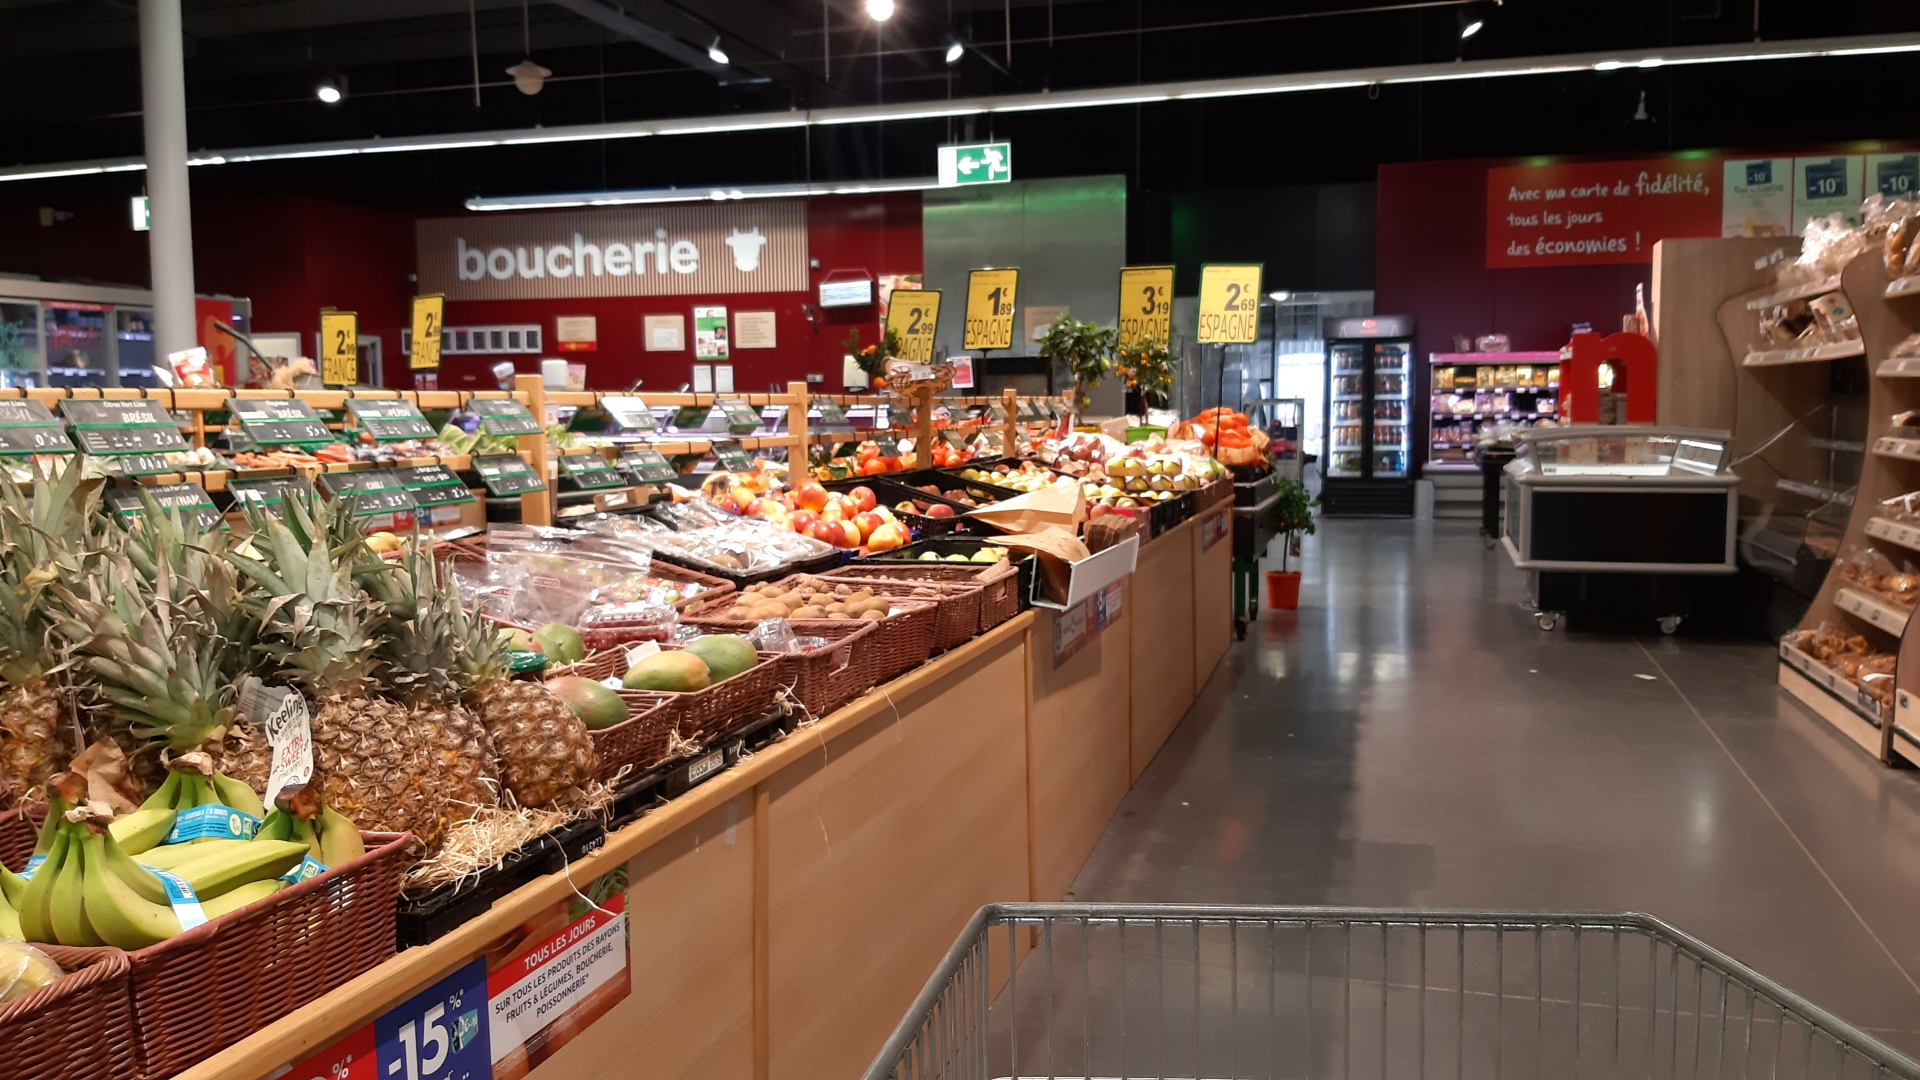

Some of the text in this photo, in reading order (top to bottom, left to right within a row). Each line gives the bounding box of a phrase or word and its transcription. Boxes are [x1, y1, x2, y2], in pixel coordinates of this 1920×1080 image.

[1508, 171, 1710, 201] Avec ma carte de fidélité,
[1507, 210, 1603, 229] tous les jours
[457, 228, 700, 281] boucherie
[1507, 240, 1531, 256] des
[1535, 236, 1628, 255] économies
[965, 319, 1011, 346] ESPAGNE
[1199, 314, 1255, 341] ESPAGNE
[323, 357, 357, 382] FRANCE
[121, 410, 157, 423] BRÉSIL
[280, 744, 304, 773] SWEET
[281, 733, 304, 760] EXTRA
[524, 915, 596, 970] TOUS LES JOURS
[495, 921, 621, 1015] SUR TOUS LES PRODUITS DES RAYONS
[506, 998, 532, 1023] FRUITS
[533, 995, 539, 1004] &
